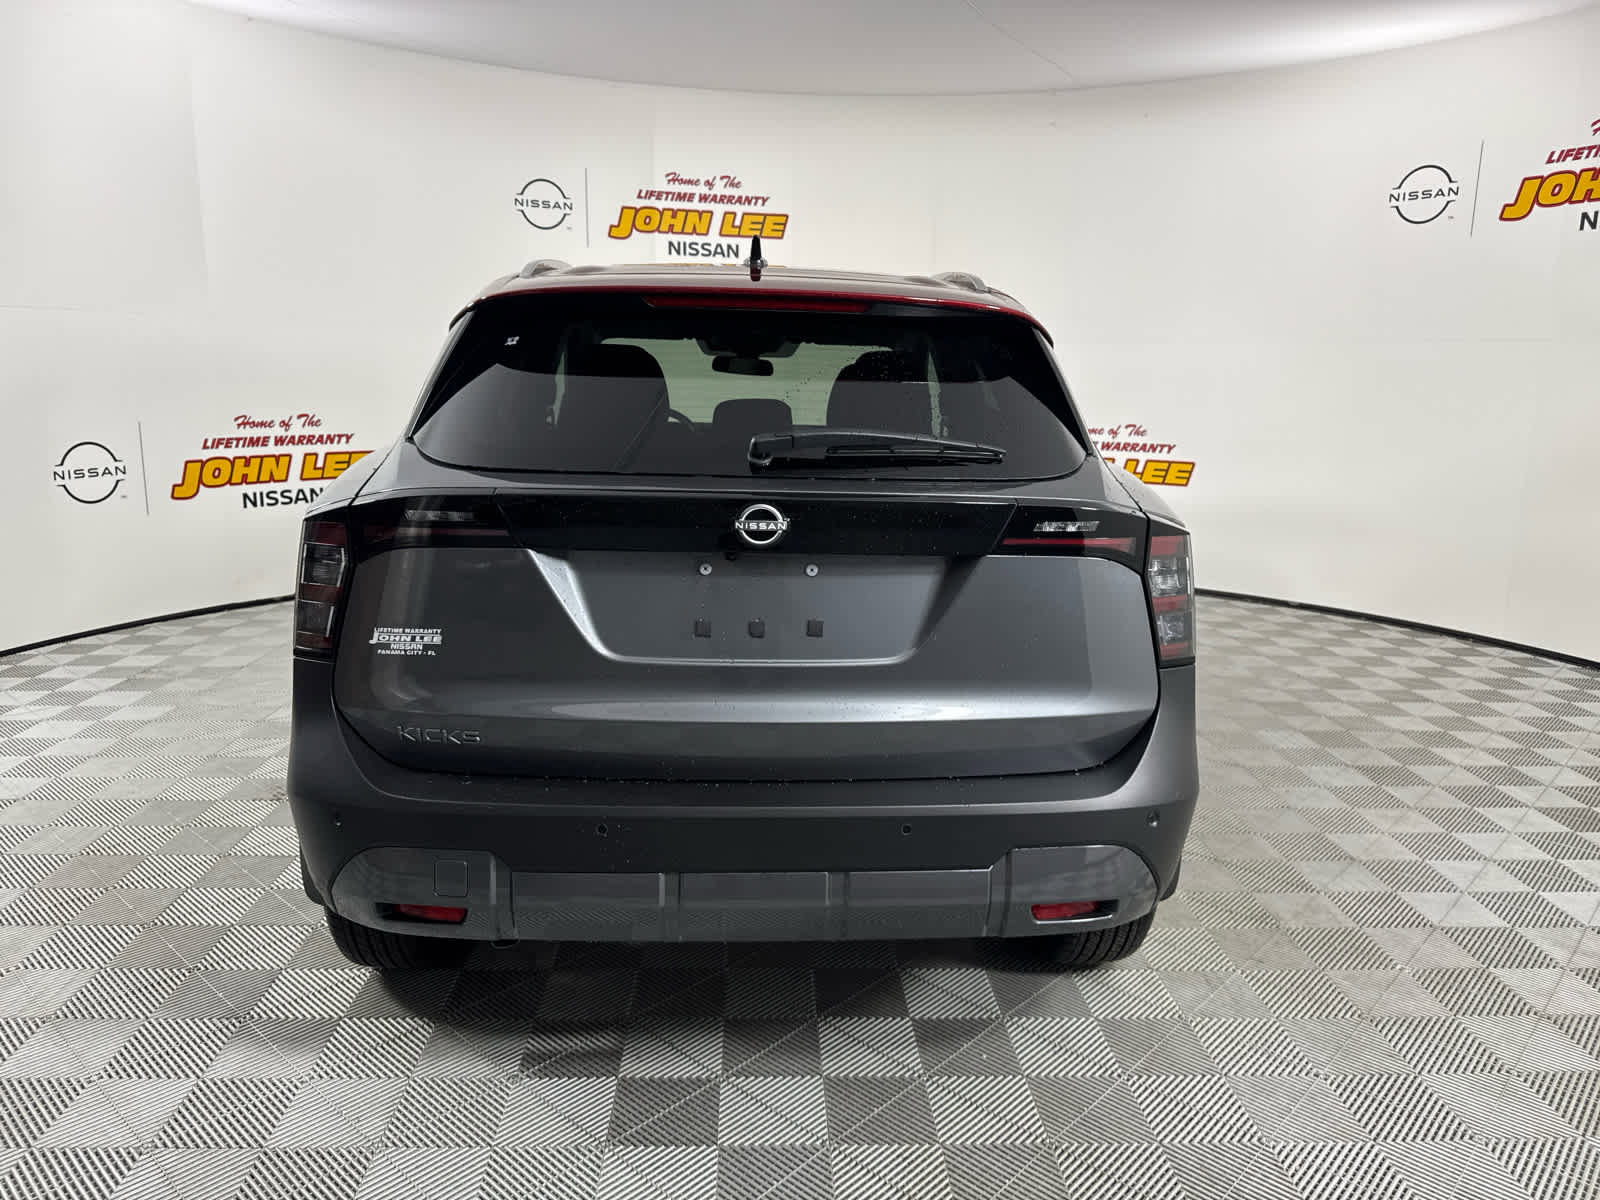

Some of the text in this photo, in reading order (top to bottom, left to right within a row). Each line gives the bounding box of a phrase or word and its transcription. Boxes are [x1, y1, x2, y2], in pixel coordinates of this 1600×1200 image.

[1545, 144, 1600, 164] LIFETI
[665, 171, 742, 190] Home of The
[637, 189, 770, 207] LIFETIME WARRANTY
[1389, 186, 1459, 203] NISSAN
[1499, 167, 1600, 221] JOH
[514, 197, 573, 211] NISSAN
[608, 206, 789, 239] JOHN LEE
[667, 241, 740, 258] NISSAN
[233, 414, 321, 431] Home of The
[1108, 424, 1121, 439] of
[1125, 424, 1147, 437] The
[201, 433, 354, 450] LIFETIME WARRANTY
[1101, 441, 1176, 454] WARRANTY
[53, 465, 127, 481] NISSAN
[170, 453, 292, 500] JOHN
[1124, 458, 1195, 487] LEE
[735, 521, 788, 531] NISSAN
[368, 632, 442, 645] JOHN LEE
[397, 726, 481, 744] KICKS
